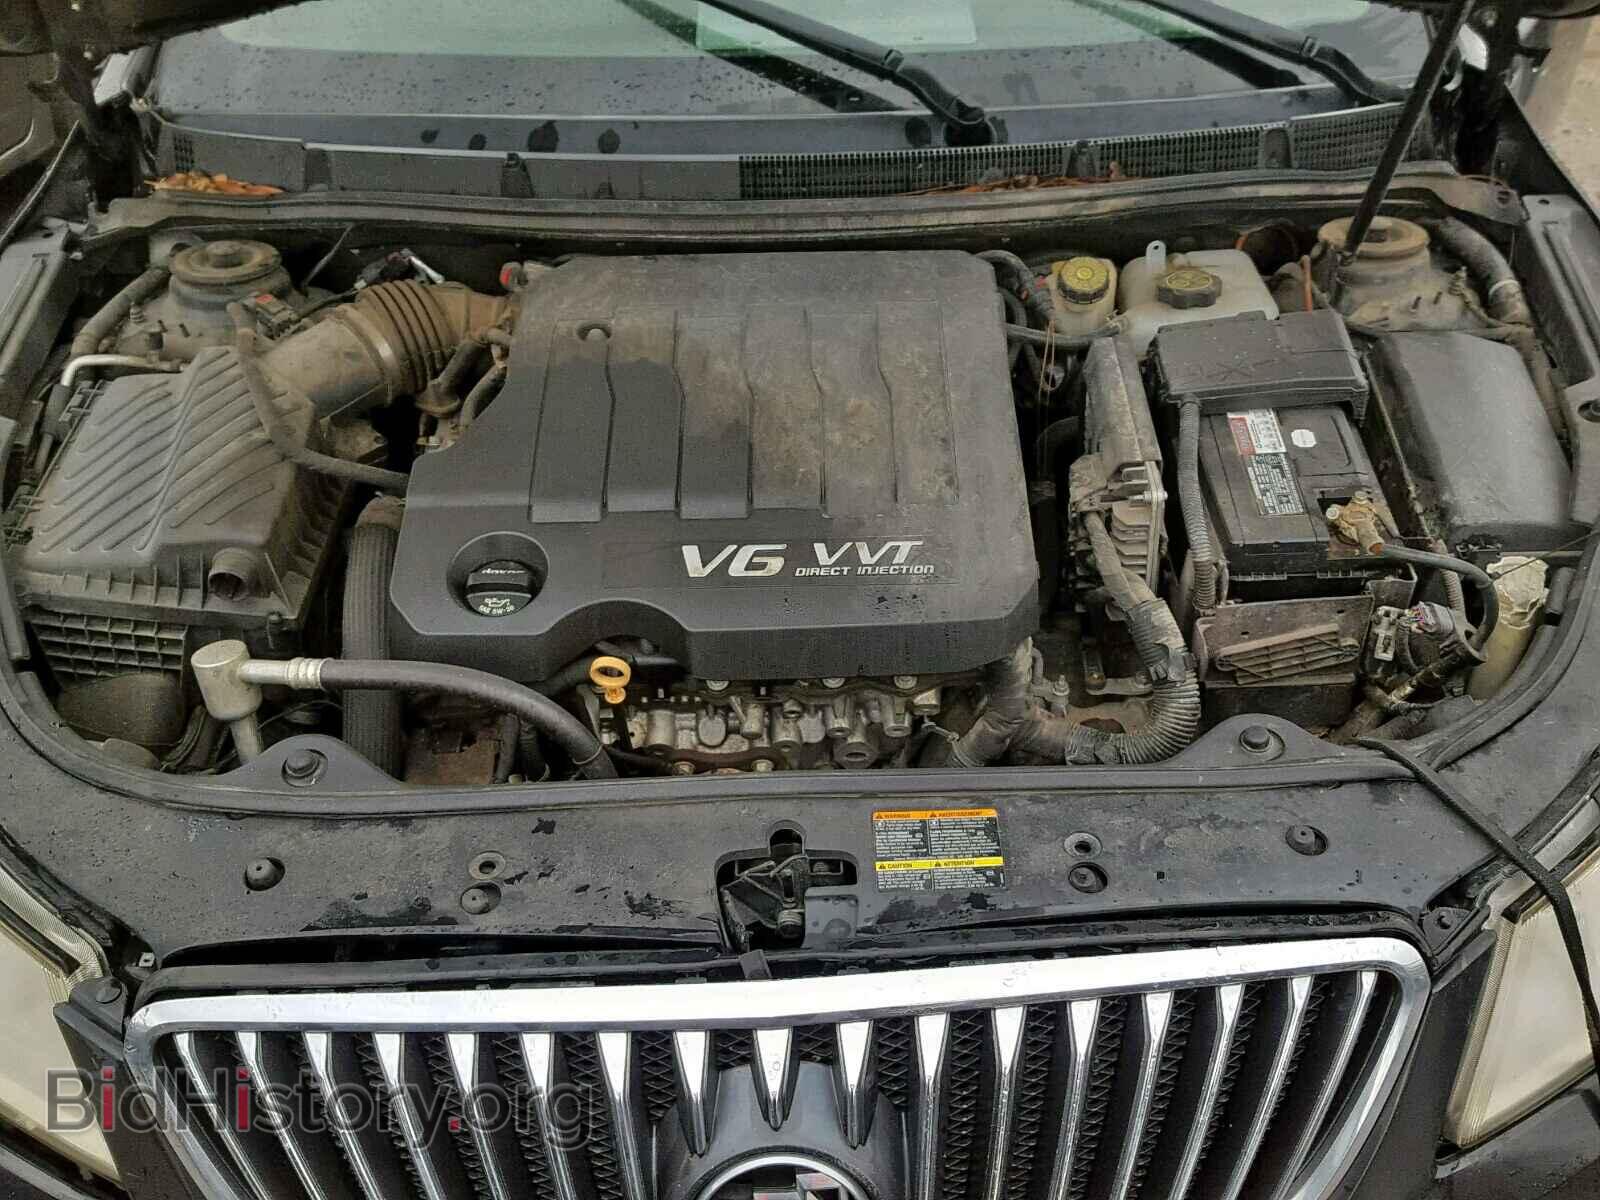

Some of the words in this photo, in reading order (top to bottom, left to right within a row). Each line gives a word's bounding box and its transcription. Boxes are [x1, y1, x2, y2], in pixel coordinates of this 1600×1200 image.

[681, 543, 787, 578] V6
[813, 540, 924, 565] VVT
[795, 566, 850, 577] DIRECT
[856, 564, 935, 576] INJECTION
